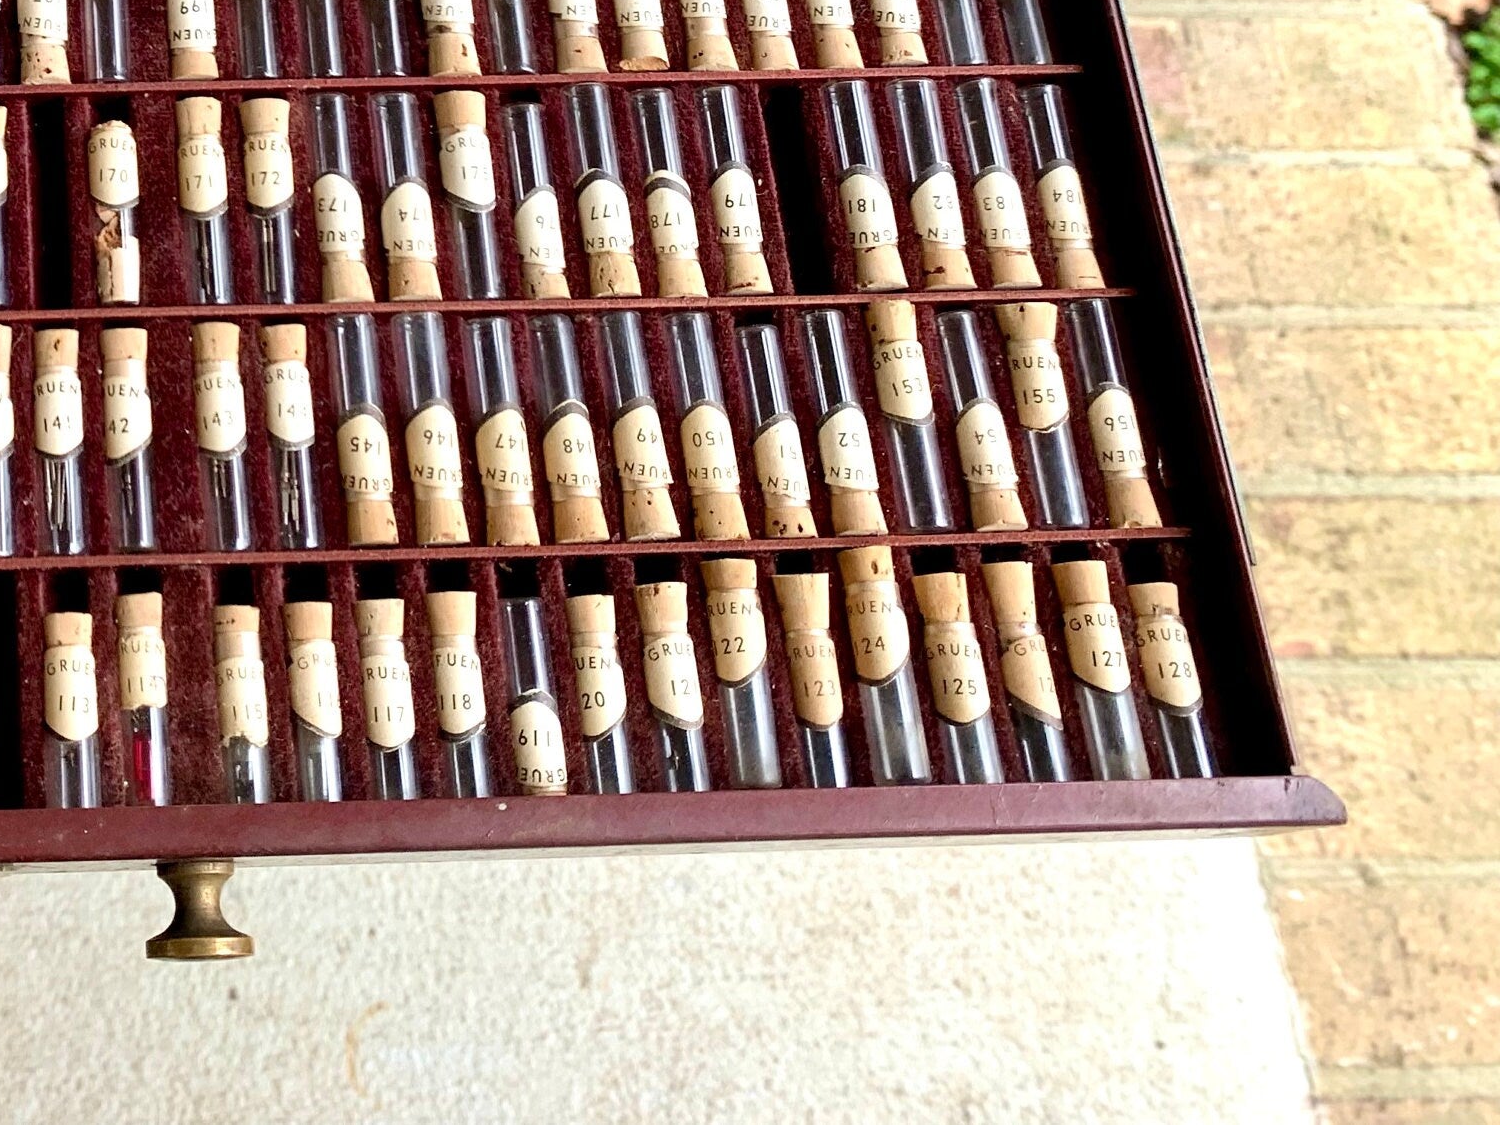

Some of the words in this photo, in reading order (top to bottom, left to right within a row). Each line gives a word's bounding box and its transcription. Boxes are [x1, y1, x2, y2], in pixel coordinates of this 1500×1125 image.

[180, 0, 208, 13] 199
[99, 170, 128, 183] 170
[186, 175, 213, 190] 171
[251, 171, 280, 186] 172
[725, 194, 753, 208] 179
[983, 196, 1013, 211] 183
[1052, 189, 1081, 203] 184
[319, 198, 347, 214] 173
[591, 205, 620, 220] 177
[849, 198, 876, 213] 181
[651, 214, 681, 228] 178
[892, 378, 923, 397] 153
[1023, 389, 1056, 405] 155
[202, 410, 234, 430] 143
[1104, 415, 1135, 432] 156
[351, 436, 382, 455] 145
[423, 429, 454, 446] 146
[495, 433, 525, 451] 147
[563, 438, 593, 454] 148
[692, 429, 724, 447] 150
[713, 636, 745, 654] 122
[853, 636, 886, 656] 124
[1093, 650, 1122, 668] 127
[1157, 661, 1192, 680] 128
[804, 679, 836, 697] 123
[942, 678, 977, 696] 125
[58, 694, 90, 713] 113
[439, 692, 472, 712] 118
[232, 702, 264, 720] 115
[373, 706, 404, 723] 117
[517, 729, 551, 747] 119
